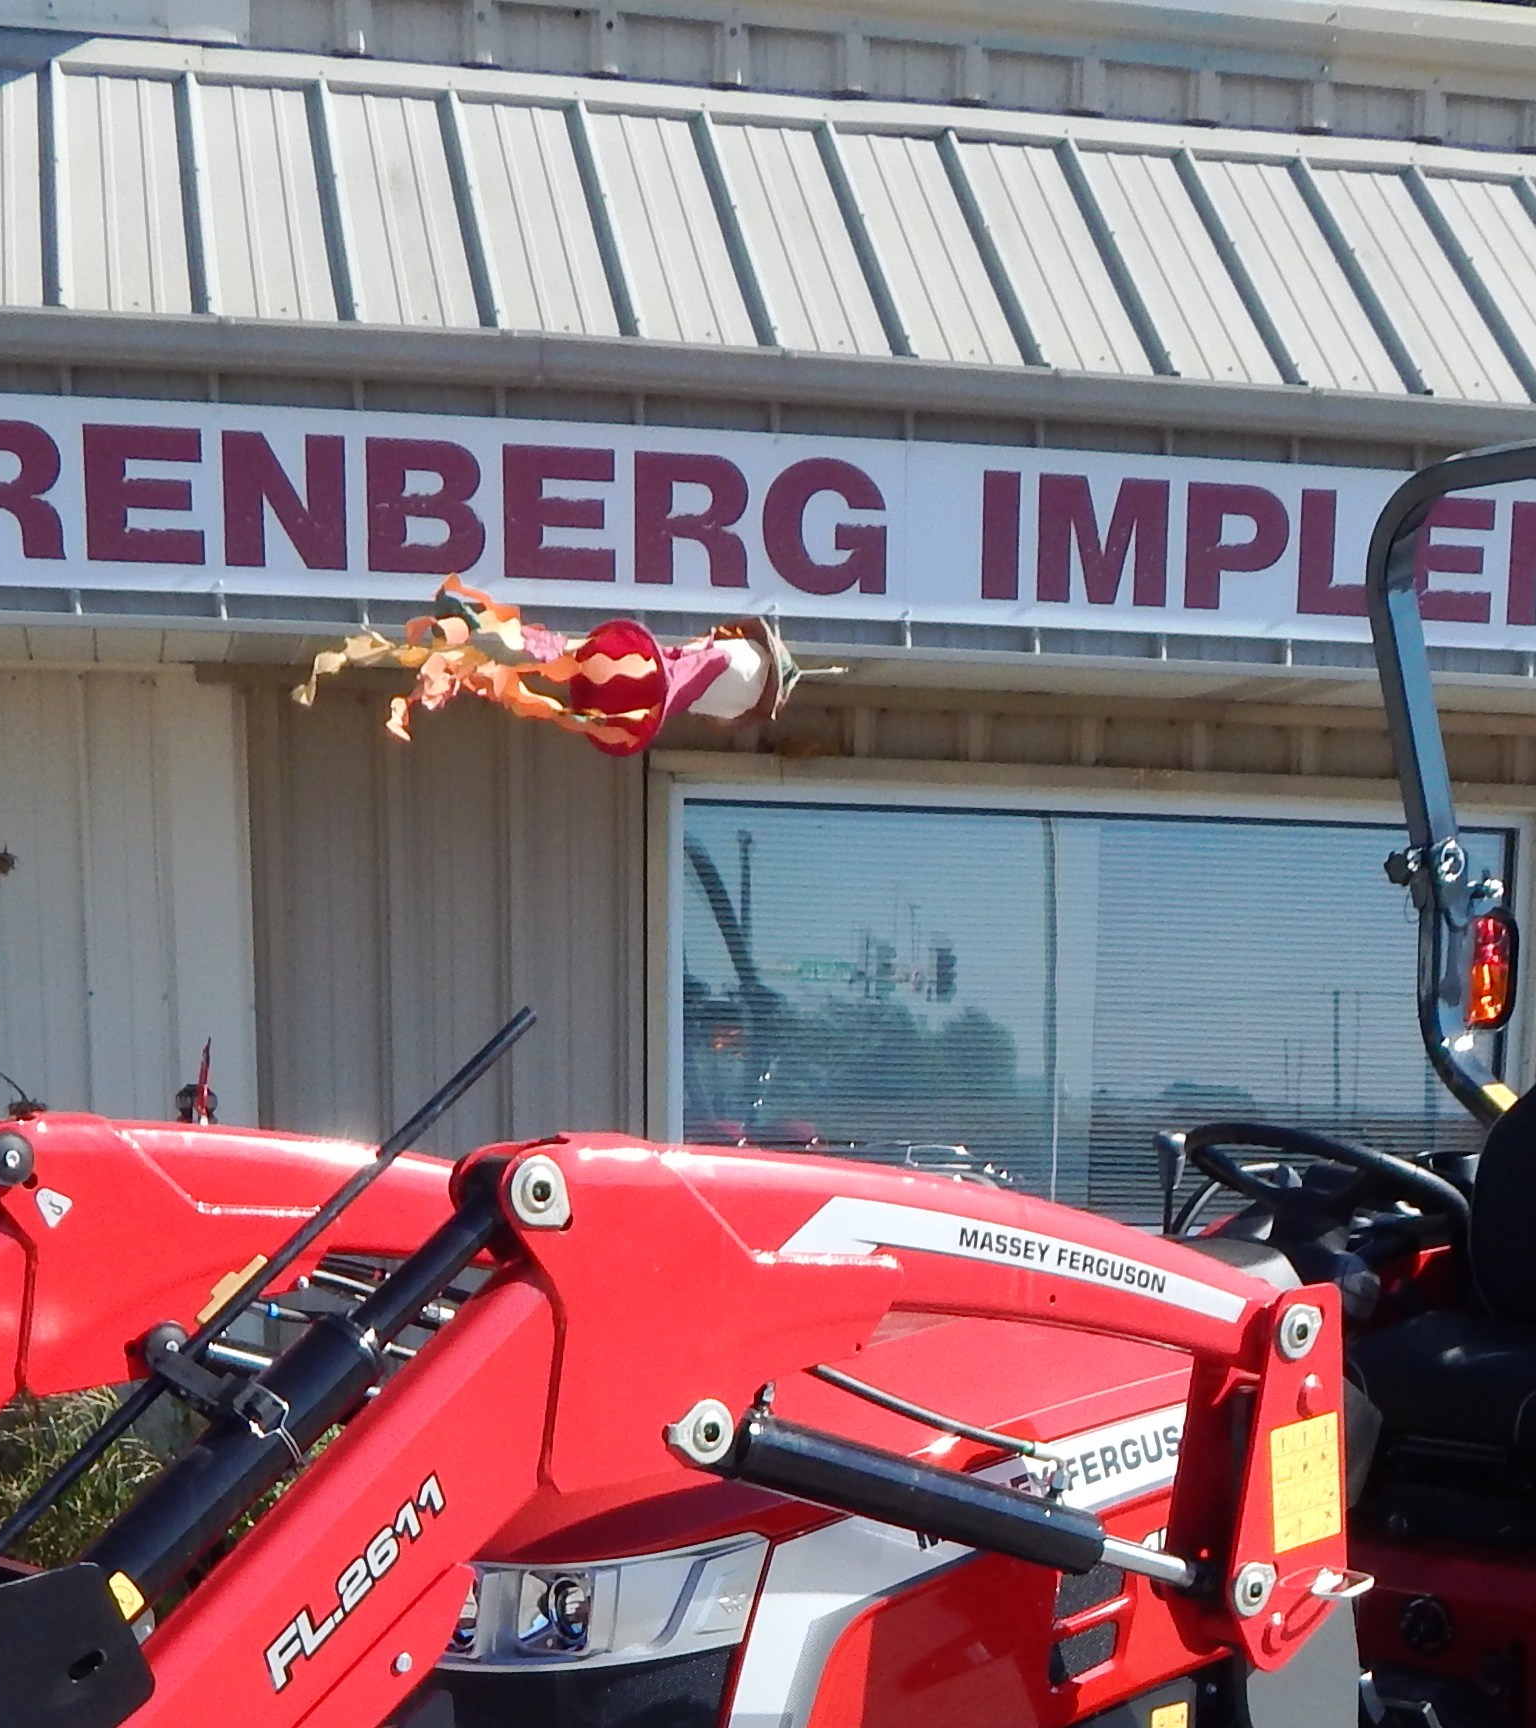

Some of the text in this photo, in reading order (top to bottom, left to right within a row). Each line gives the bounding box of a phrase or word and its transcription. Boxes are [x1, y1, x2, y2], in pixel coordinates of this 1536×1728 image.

[958, 1227, 1167, 1294] MASSEY FERGUSON
[264, 1470, 447, 1694] FL.2611
